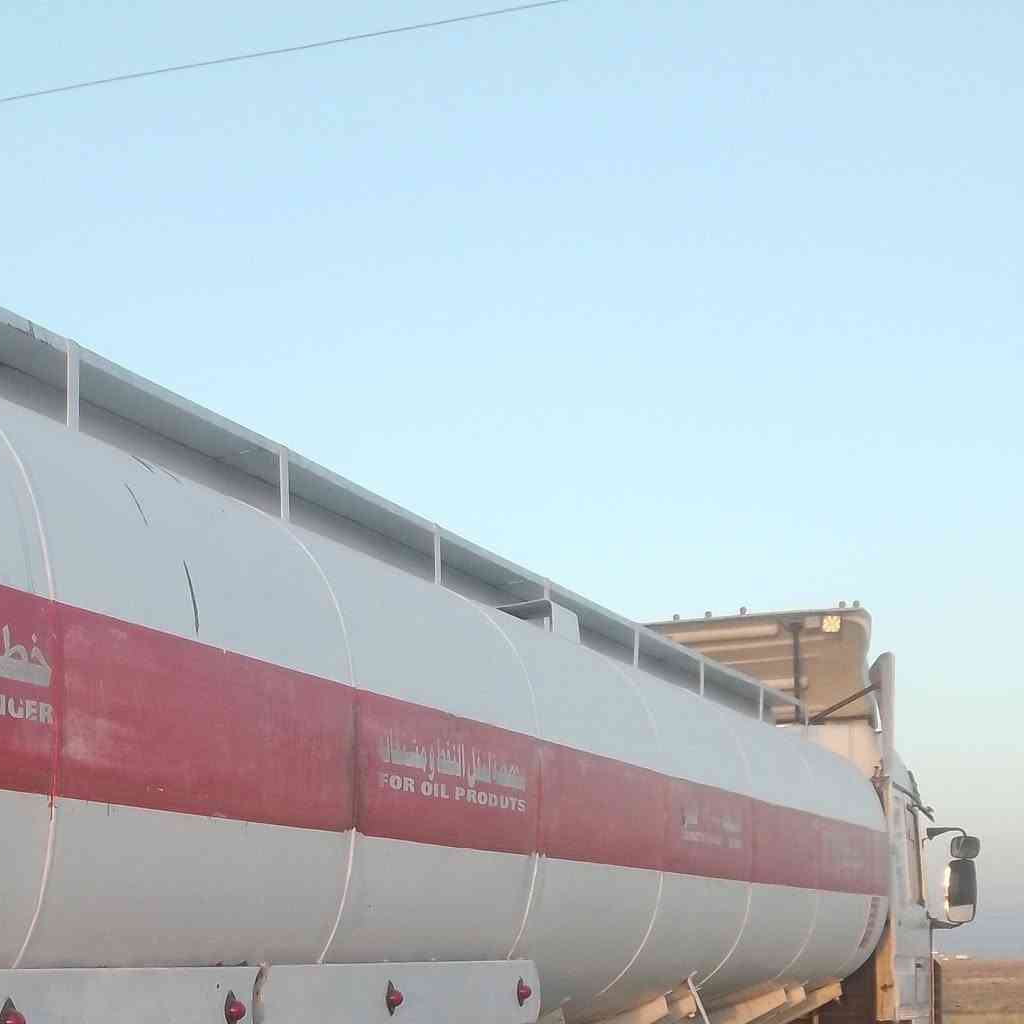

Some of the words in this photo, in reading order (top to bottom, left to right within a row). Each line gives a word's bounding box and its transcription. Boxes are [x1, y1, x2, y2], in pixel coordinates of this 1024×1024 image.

[383, 773, 415, 793] FOR
[420, 781, 450, 799] OIL
[455, 786, 527, 812] PRODUTS
